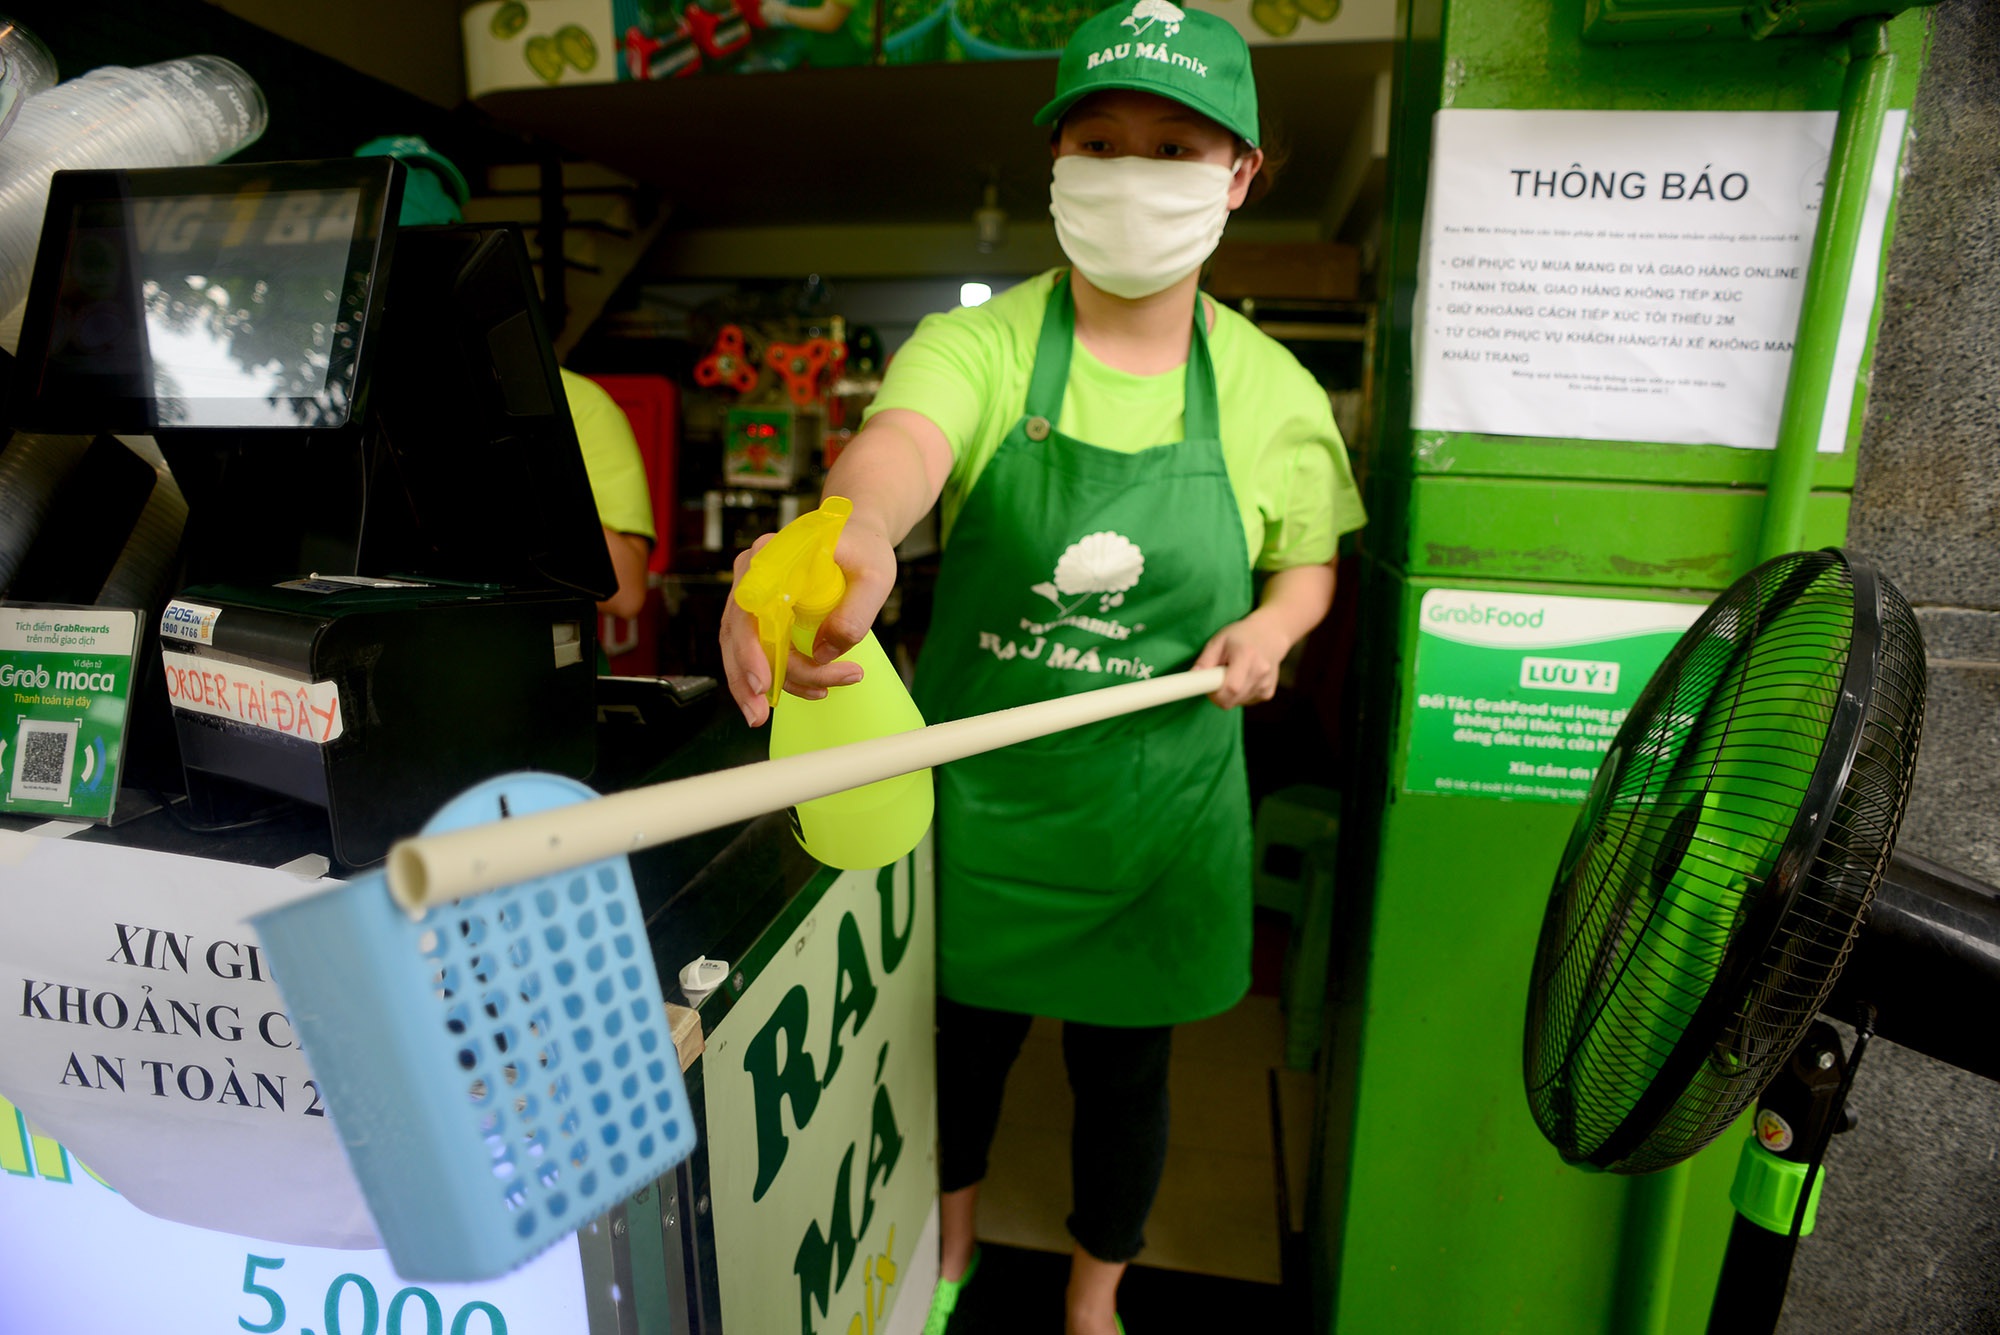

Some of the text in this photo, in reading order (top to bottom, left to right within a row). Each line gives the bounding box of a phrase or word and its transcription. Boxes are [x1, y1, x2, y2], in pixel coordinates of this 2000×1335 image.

[1087, 42, 1131, 70] RAU
[1171, 52, 1208, 79] mix
[1510, 162, 1749, 201] THÔNG BÁO
[1478, 258, 1515, 271] PHỤC
[1520, 258, 1538, 271] VỤ
[1541, 260, 1571, 271] MUA
[1575, 261, 1615, 273] MANG
[1619, 264, 1633, 274] ĐI
[1637, 261, 1655, 275] VÀ
[1660, 264, 1695, 276] GIAO
[1699, 262, 1740, 277] HÀNG
[1744, 266, 1800, 279] ONLINE
[1450, 280, 1495, 292] THANH
[1544, 283, 1578, 295] GIAO
[1581, 283, 1620, 297] HÀNG
[1625, 286, 1675, 299] KHÔNG
[1680, 286, 1709, 300] TIẾP
[1713, 288, 1743, 301] XÚC
[1475, 303, 1534, 317] KHOẢNG
[1538, 305, 1576, 319] CÁCH
[1715, 314, 1735, 326] 2M
[1504, 328, 1542, 342] PHỤC
[1545, 331, 1563, 344] VỤ
[1566, 331, 1614, 345] KHÁCH
[1708, 337, 1760, 351] KHÔNG
[1764, 341, 1796, 352] MAN
[1485, 351, 1530, 364] TRANG
[15, 620, 110, 634] Tích điểm GrabRewards
[1428, 603, 1545, 630] GrabFood
[27, 634, 42, 644] trên
[60, 636, 77, 646] giao
[78, 637, 96, 647] dịch
[162, 622, 198, 639] 1900 4766
[1046, 643, 1103, 673] MÁ
[1106, 656, 1154, 680] mix
[0, 664, 115, 692] Grab moca
[1529, 664, 1577, 684] LƯU
[14, 693, 92, 709] Thanh toán tại đây
[165, 665, 337, 742] ORDER TẠI ĐÂY
[1447, 695, 1472, 711] Tác
[1474, 697, 1549, 716] GrabFood
[1550, 704, 1575, 719] vui
[1575, 705, 1610, 724] lòng
[1611, 708, 1630, 724] gi
[1454, 712, 1500, 731] không
[1529, 717, 1563, 734] thúc
[1565, 718, 1584, 735] và
[1453, 728, 1493, 747] đông
[1523, 734, 1566, 750] trước
[1508, 761, 1535, 777] Xin
[1569, 766, 1591, 781] ơn
[106, 923, 277, 983] XIN GI
[19, 978, 245, 1042] KHOẢNG
[743, 848, 915, 1202] RAU
[59, 1051, 126, 1093] AN
[141, 1057, 288, 1113] TOÀN
[794, 1040, 904, 1335] MÁ
